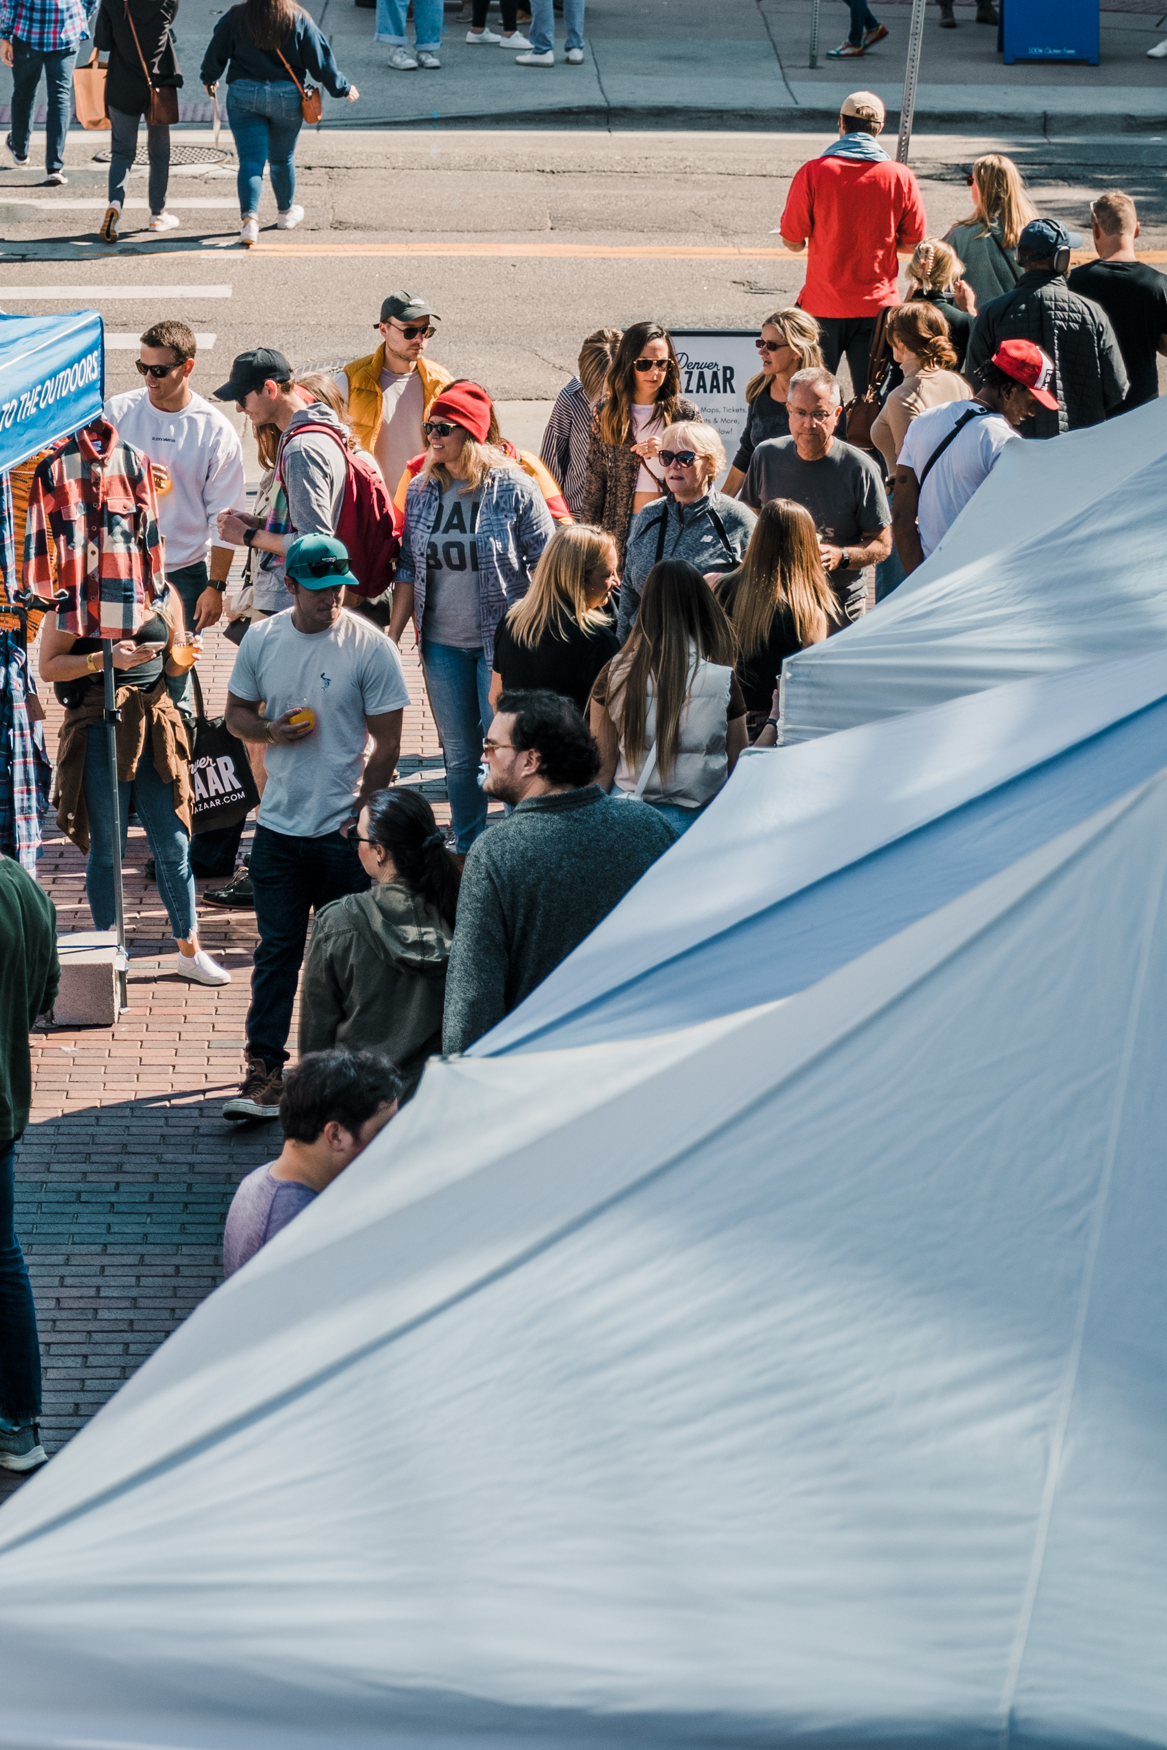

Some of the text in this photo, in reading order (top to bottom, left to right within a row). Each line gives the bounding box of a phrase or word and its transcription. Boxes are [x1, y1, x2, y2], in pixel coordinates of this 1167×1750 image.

[675, 352, 720, 371] Denver
[17, 384, 41, 423] THE
[38, 350, 99, 409] OUTDOORS
[680, 366, 735, 393] ZAAR
[723, 406, 747, 414] Tickets,
[189, 756, 216, 774] ver
[193, 755, 242, 803] AAR
[194, 791, 245, 814] AZAAR.COM
